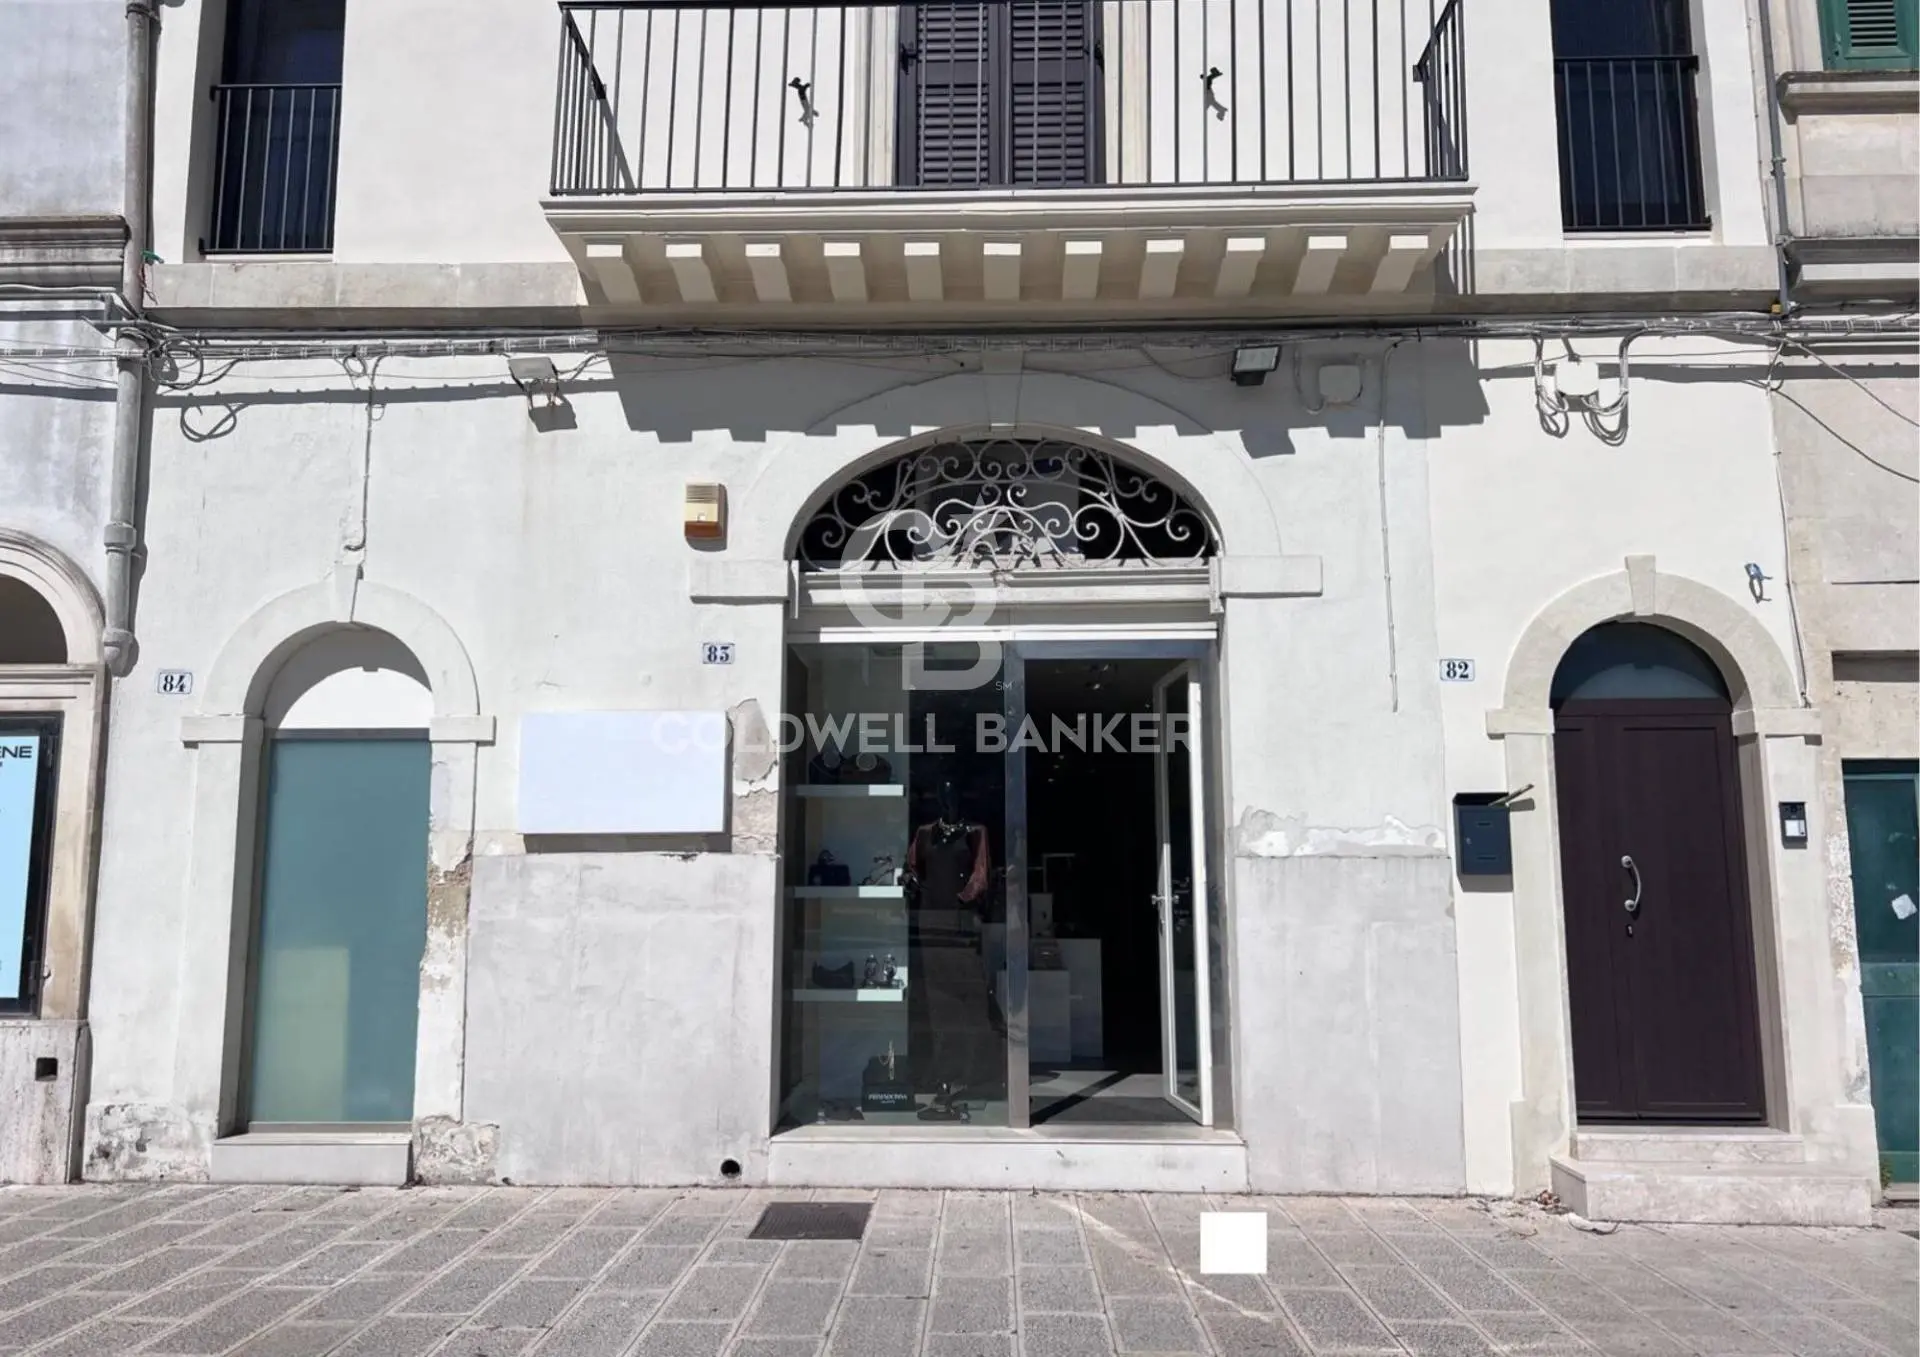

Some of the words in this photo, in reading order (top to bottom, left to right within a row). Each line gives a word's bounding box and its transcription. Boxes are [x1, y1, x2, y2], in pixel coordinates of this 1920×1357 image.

[1446, 660, 1470, 679] 82
[163, 674, 186, 692] 84
[0, 745, 33, 759] NE
